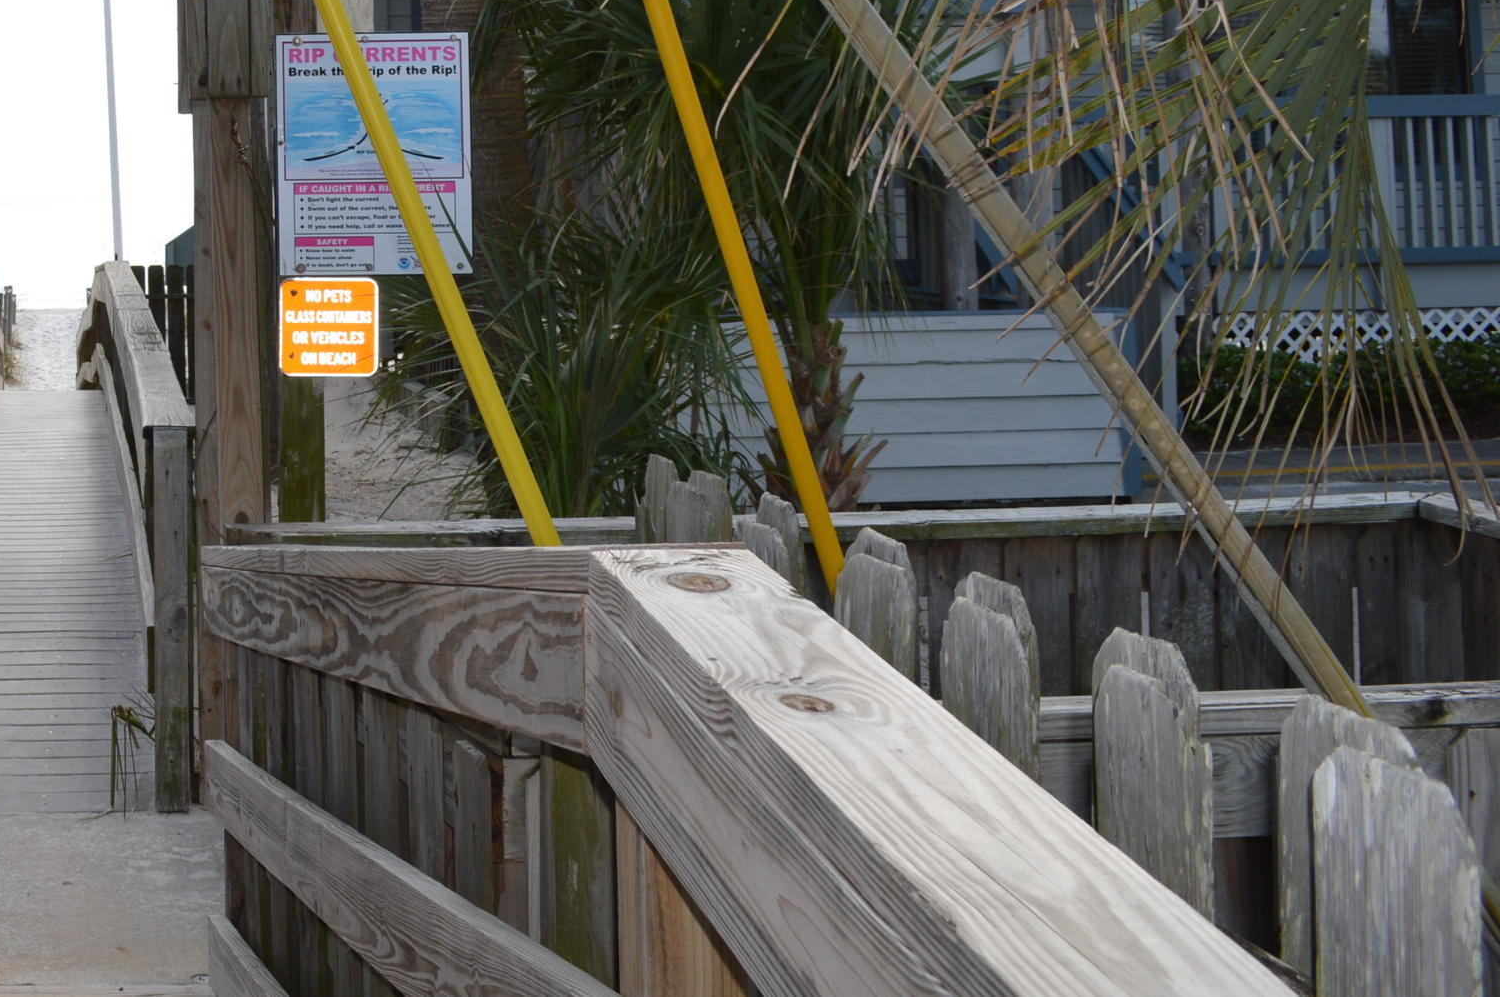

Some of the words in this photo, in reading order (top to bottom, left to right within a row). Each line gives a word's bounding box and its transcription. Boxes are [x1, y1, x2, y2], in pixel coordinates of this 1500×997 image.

[288, 47, 325, 63] RIP
[333, 45, 457, 63] RRENTS
[288, 67, 327, 77] Break
[332, 66, 345, 76] th
[388, 66, 401, 75] of
[406, 65, 428, 75] the
[431, 64, 458, 76] Rip!
[299, 185, 308, 193] IF
[311, 185, 353, 193] CAUGHT
[355, 184, 366, 192] IN
[369, 184, 376, 192] A
[378, 184, 389, 192] RI
[316, 238, 348, 246] SAFETY
[305, 289, 322, 303] NO
[323, 289, 352, 303] PETS
[285, 310, 315, 324] GLASS
[316, 310, 373, 324] CONTAINERS
[292, 331, 309, 344] OR
[310, 331, 365, 345] VEHICLES
[301, 352, 318, 365] ON
[319, 352, 357, 365] BEACH
